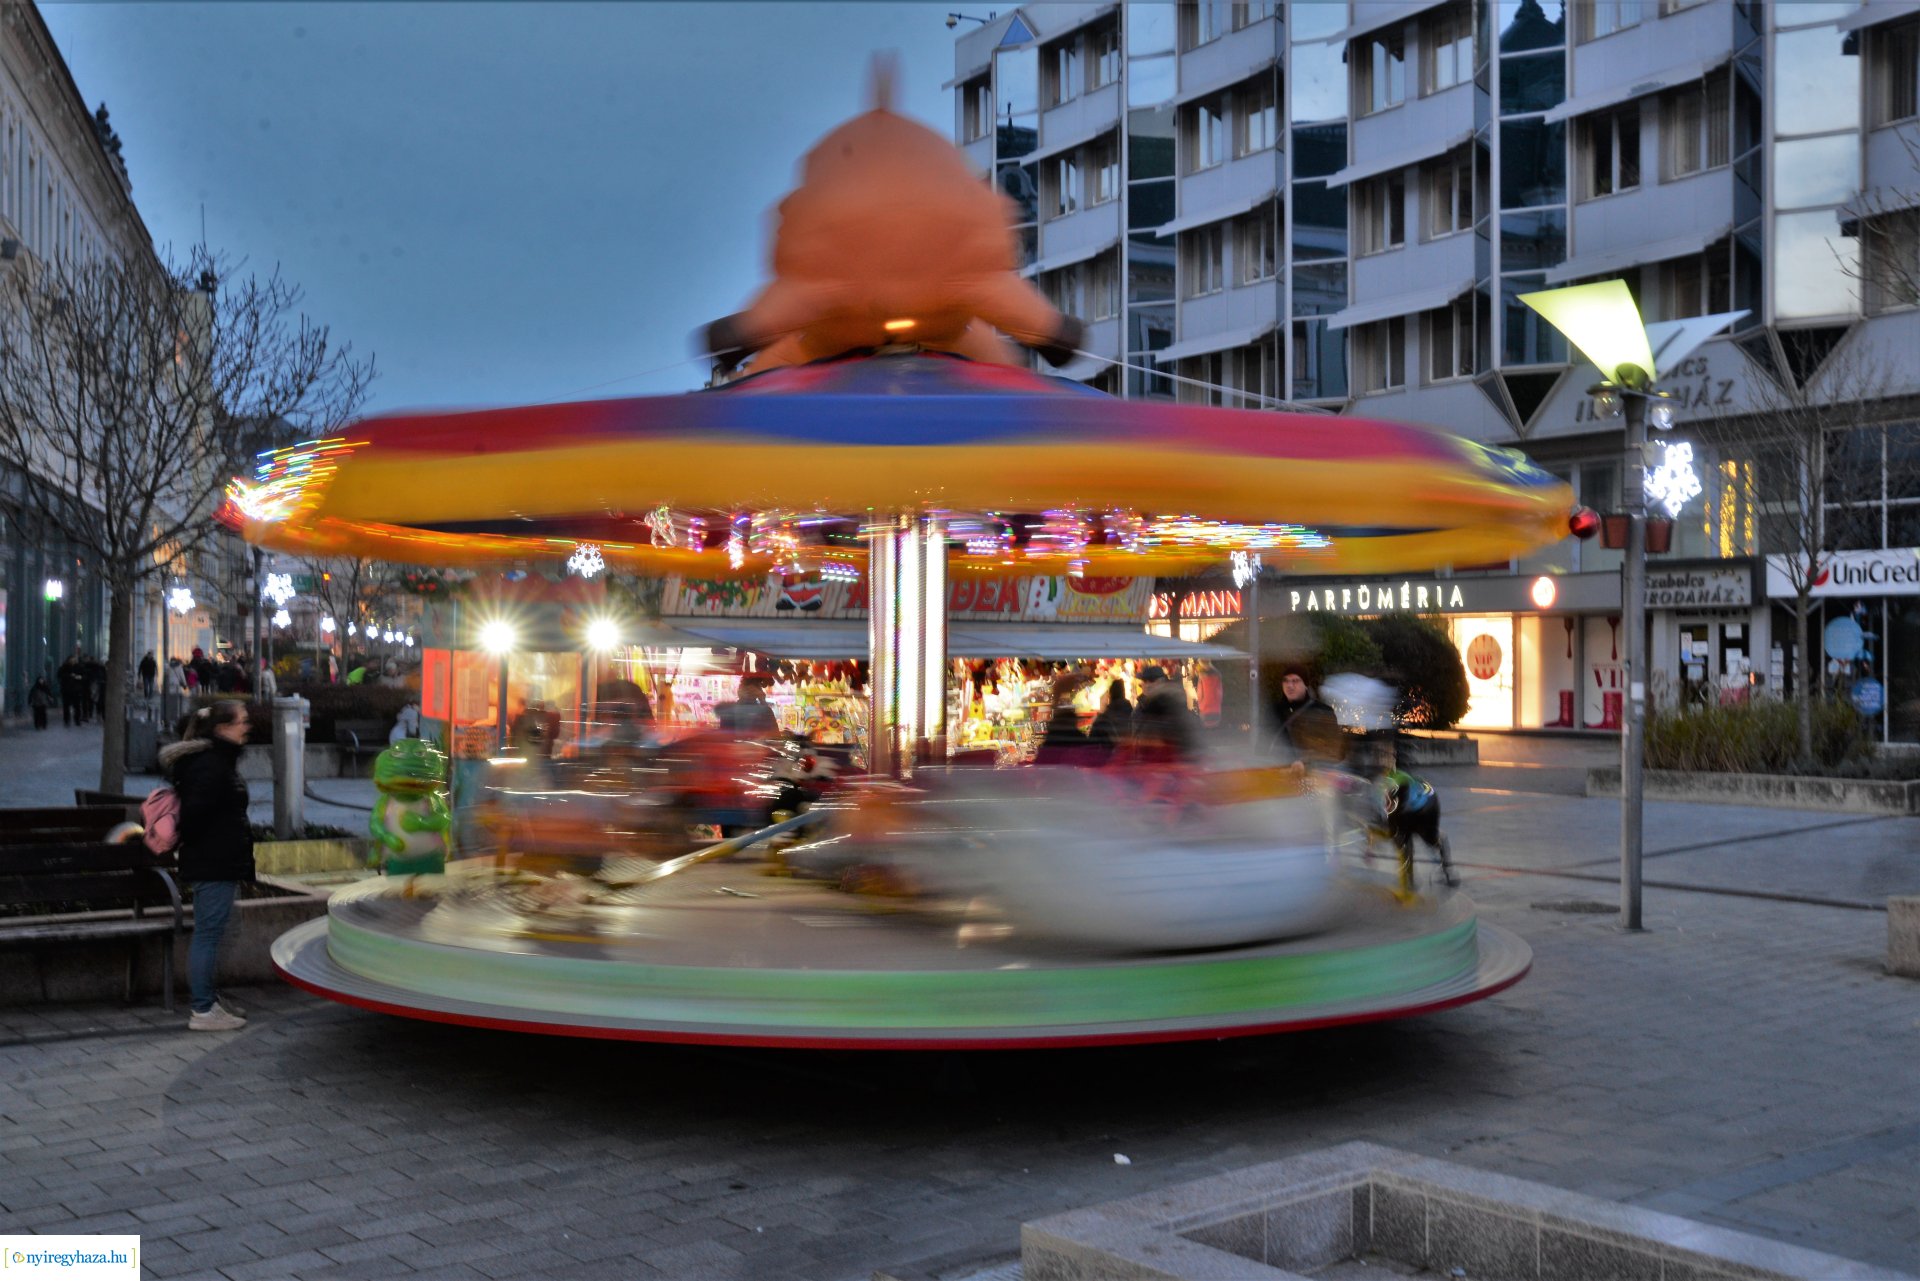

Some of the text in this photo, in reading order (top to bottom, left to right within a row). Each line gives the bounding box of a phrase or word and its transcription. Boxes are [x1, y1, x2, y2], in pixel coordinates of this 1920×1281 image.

[1832, 559, 1920, 586] UniCred
[1290, 581, 1464, 611] PARFÜMÉRIA
[1474, 654, 1493, 665] VIP
